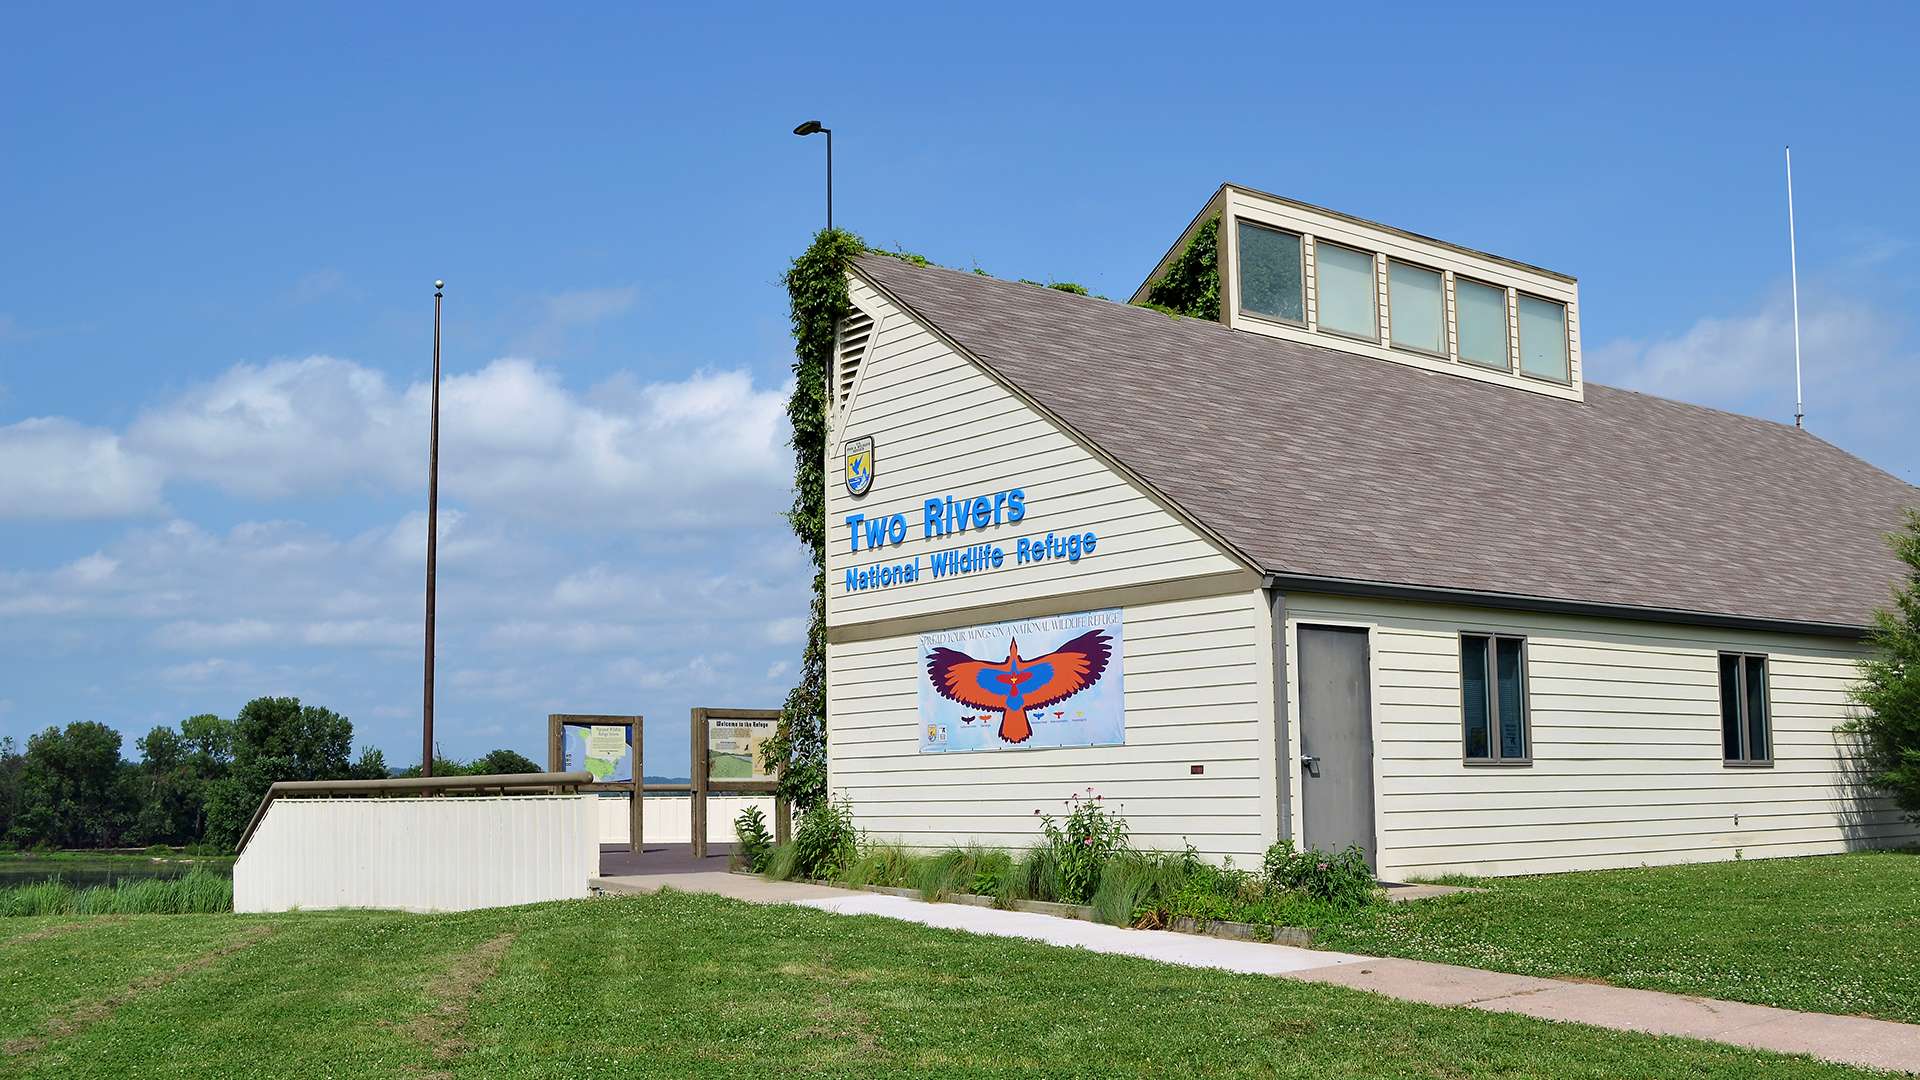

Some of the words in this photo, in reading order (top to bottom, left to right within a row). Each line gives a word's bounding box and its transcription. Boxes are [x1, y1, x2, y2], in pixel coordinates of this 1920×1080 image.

[846, 513, 907, 552] Two
[923, 488, 1025, 538] Rivers
[846, 557, 919, 591] National
[931, 544, 1005, 576] Wildlife
[1016, 532, 1098, 563] Refuge
[1012, 622, 1050, 635] NATIONAL
[1051, 617, 1085, 630] WILDLIFE
